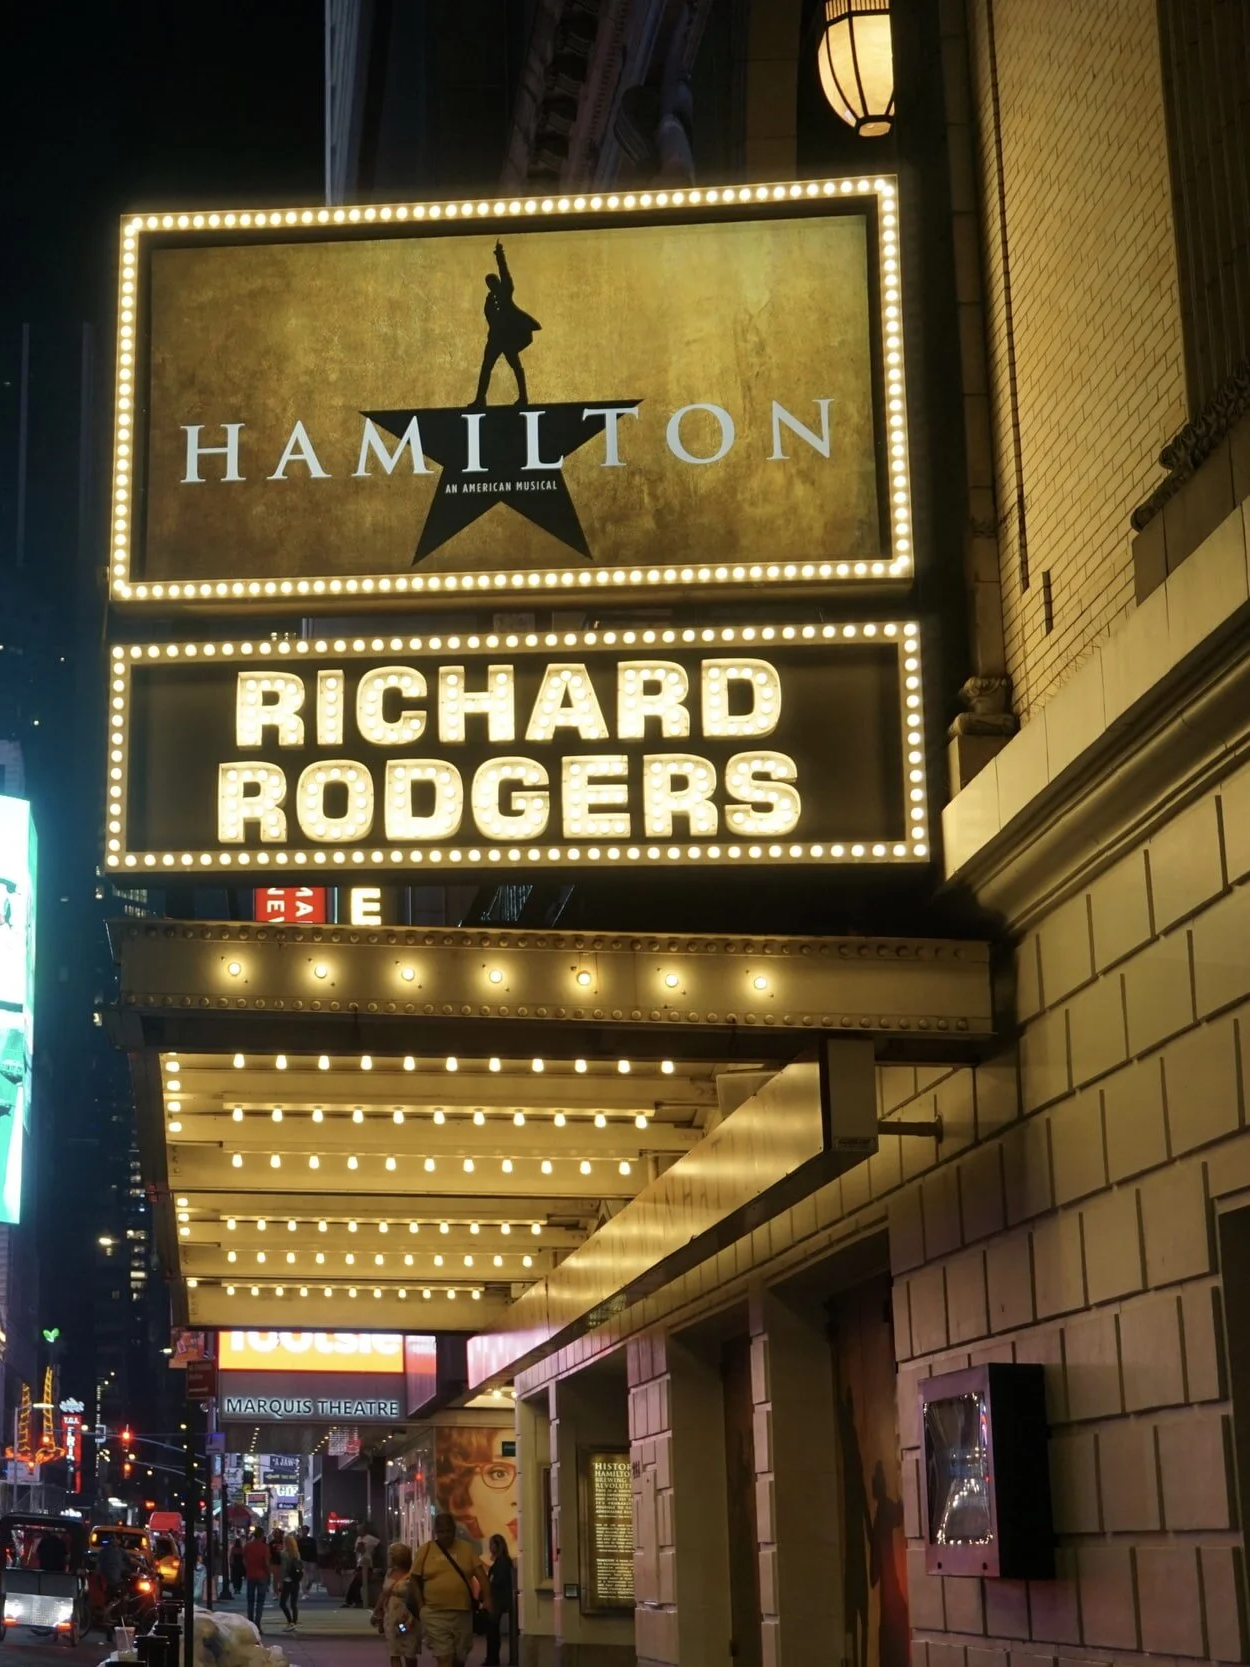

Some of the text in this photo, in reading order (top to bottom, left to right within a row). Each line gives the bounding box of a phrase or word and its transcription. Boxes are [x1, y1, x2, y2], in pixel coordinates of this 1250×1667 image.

[179, 397, 836, 484] HAMILTON
[445, 480, 558, 494] AN AMERICAN MUSICAL
[234, 658, 783, 748] RICHARD
[216, 750, 803, 844] RODGERS
[225, 1397, 400, 1416] MARQUIS THEATRE
[594, 1470, 630, 1478] HAMILTO
